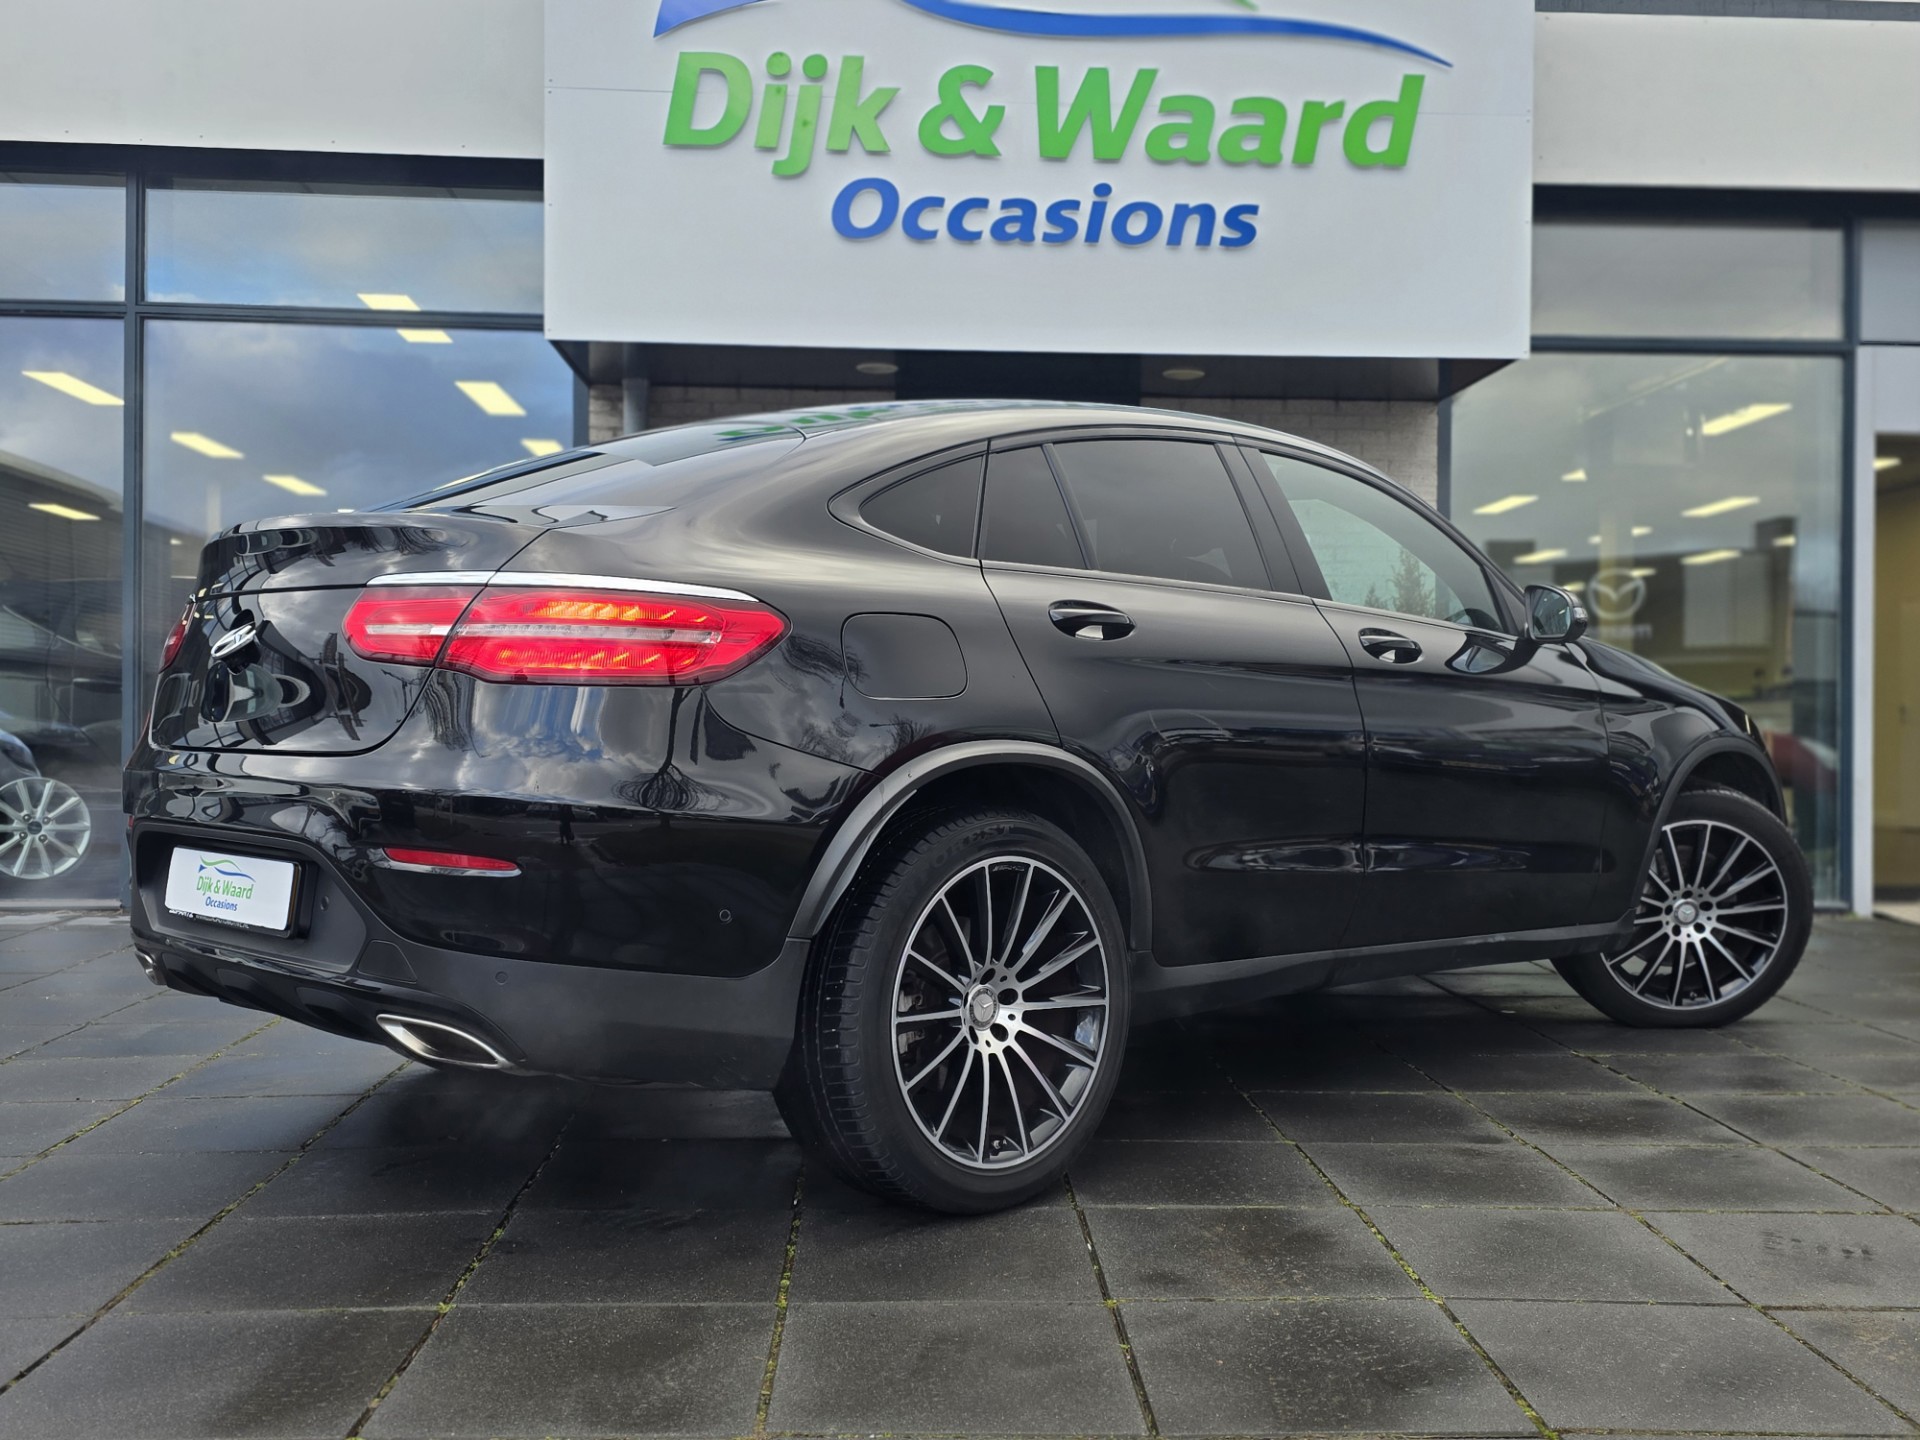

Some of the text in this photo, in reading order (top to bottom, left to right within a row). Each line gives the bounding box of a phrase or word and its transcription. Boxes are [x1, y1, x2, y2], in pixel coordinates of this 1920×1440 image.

[663, 52, 1425, 177] Dijk & Waard
[831, 177, 1260, 248] Occasions
[196, 876, 254, 900] Dijk & Waard
[205, 896, 238, 912] Occasions
